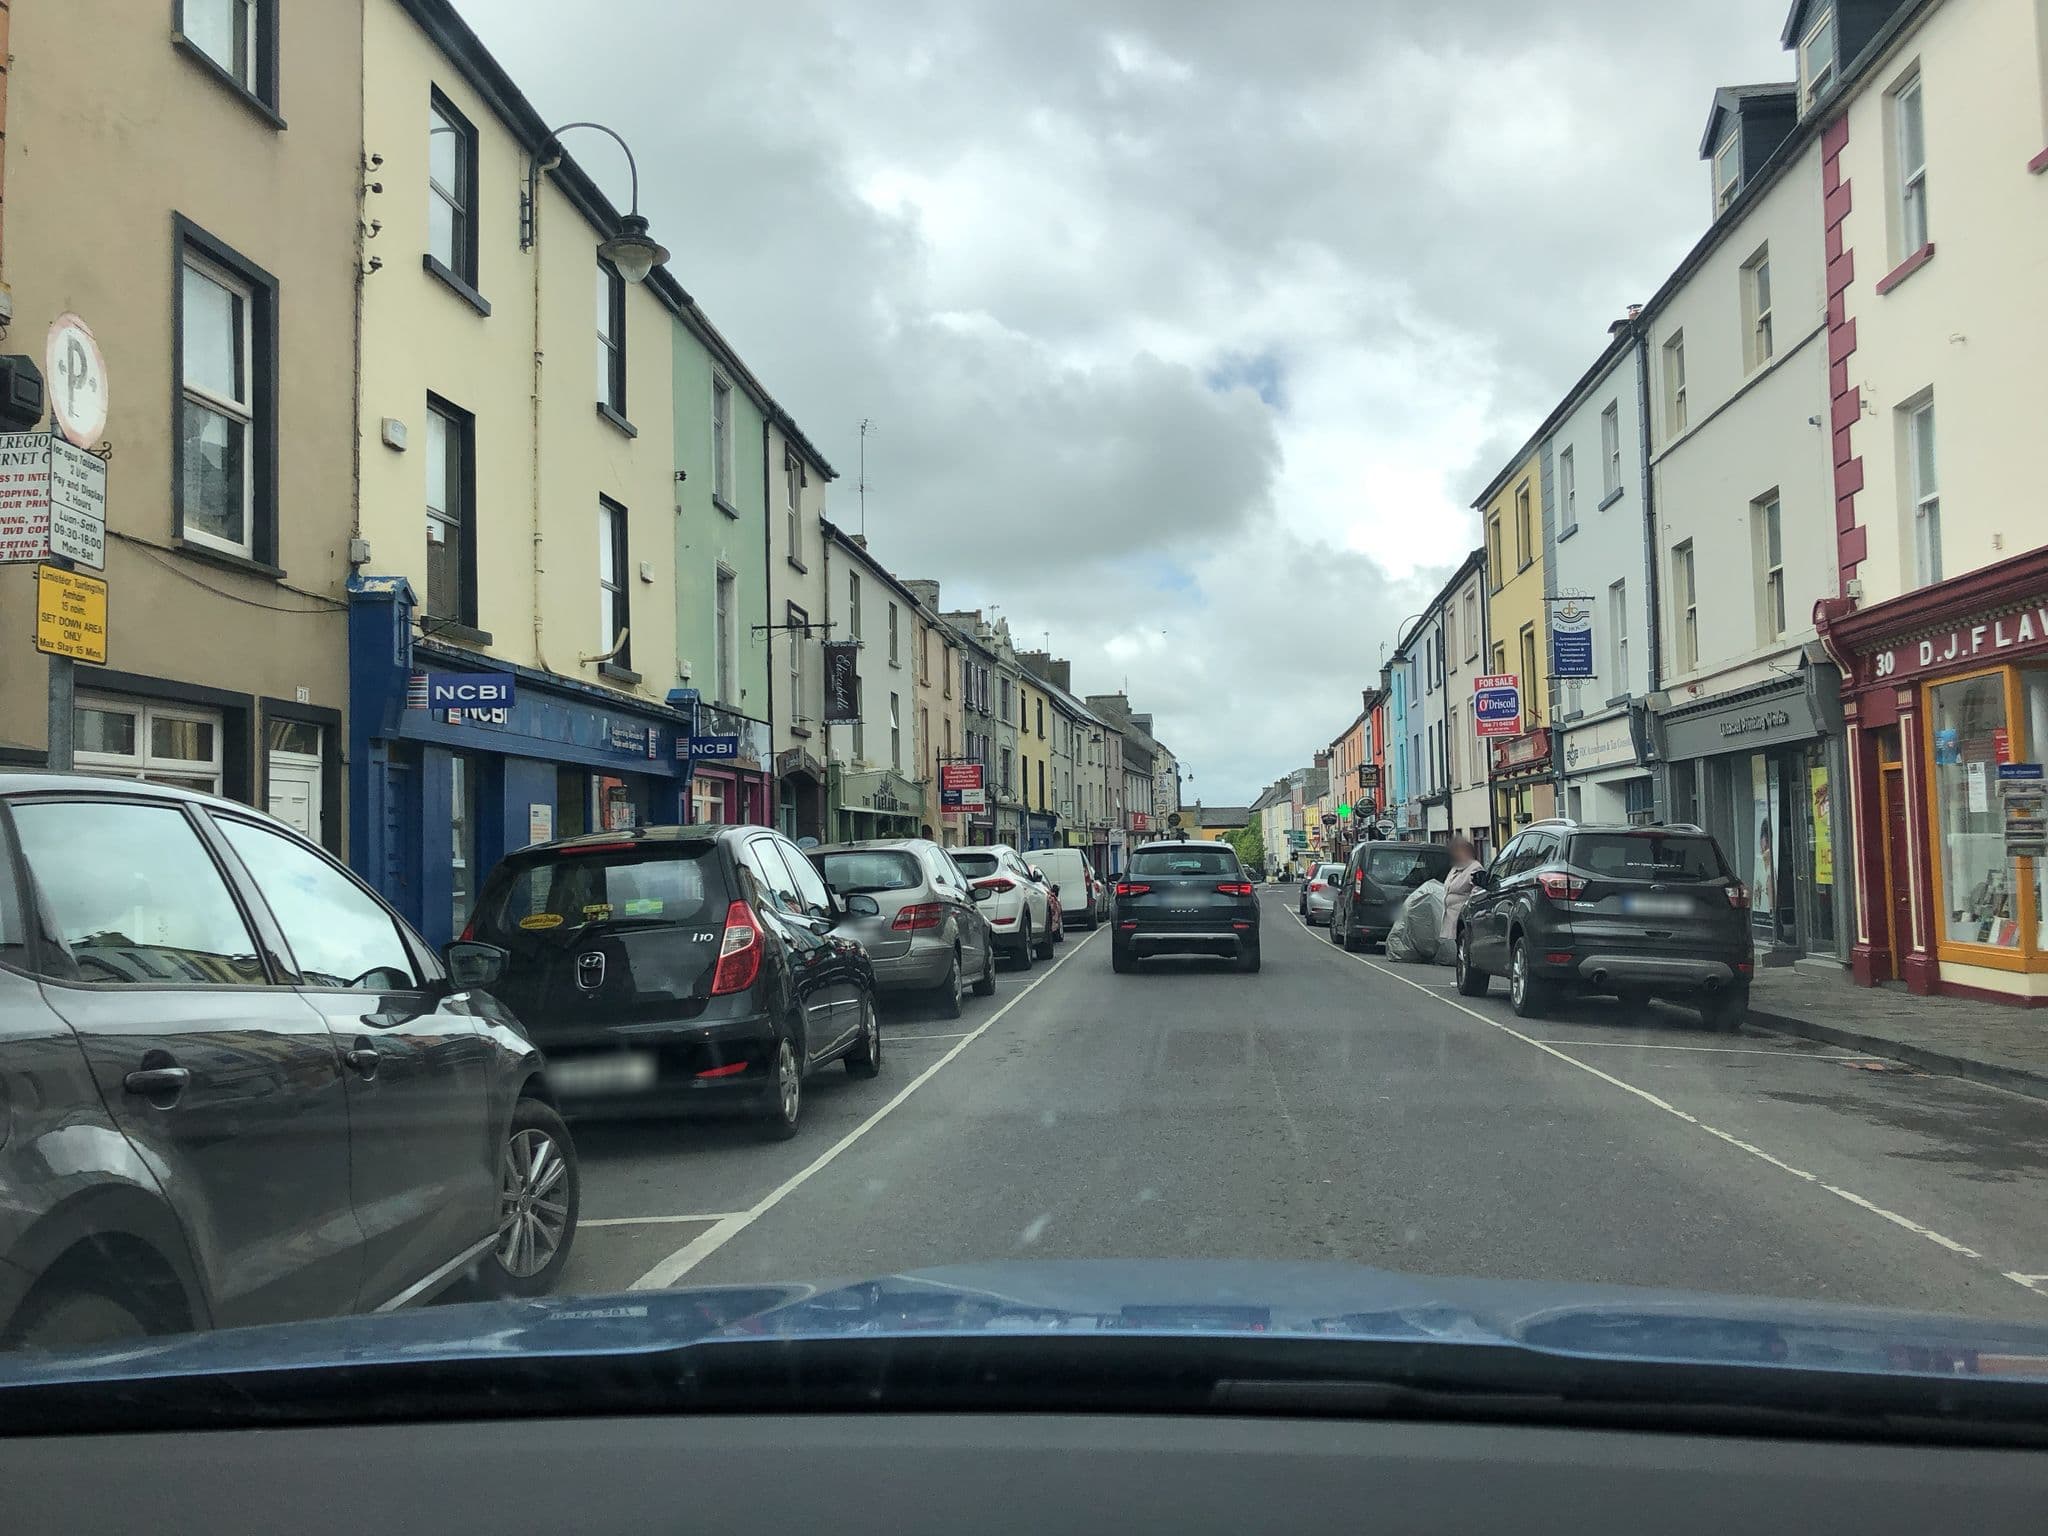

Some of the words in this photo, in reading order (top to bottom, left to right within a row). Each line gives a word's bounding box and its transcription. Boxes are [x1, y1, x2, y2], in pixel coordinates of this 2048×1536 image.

[0, 451, 39, 465] RNET
[13, 473, 24, 482] TO
[53, 472, 65, 487] Pay
[67, 480, 79, 492] and
[81, 484, 104, 504] Display
[66, 492, 71, 501] 2
[72, 495, 92, 511] Hours
[3, 526, 24, 535] DVD
[9, 550, 33, 558] INTO
[62, 540, 94, 561] Mon-Sat
[62, 602, 69, 611] 15
[41, 612, 56, 625] SET
[59, 616, 82, 630] DOWN
[84, 623, 103, 635] AREA
[63, 630, 82, 642] ONLY
[40, 637, 54, 648] Max
[57, 641, 73, 654] Stay
[76, 646, 83, 655] 15
[1875, 650, 1895, 677] 30
[1479, 679, 1494, 688] FOR
[1494, 677, 1514, 687] SALE
[435, 685, 507, 700] NCBI
[691, 744, 733, 754] NCBI
